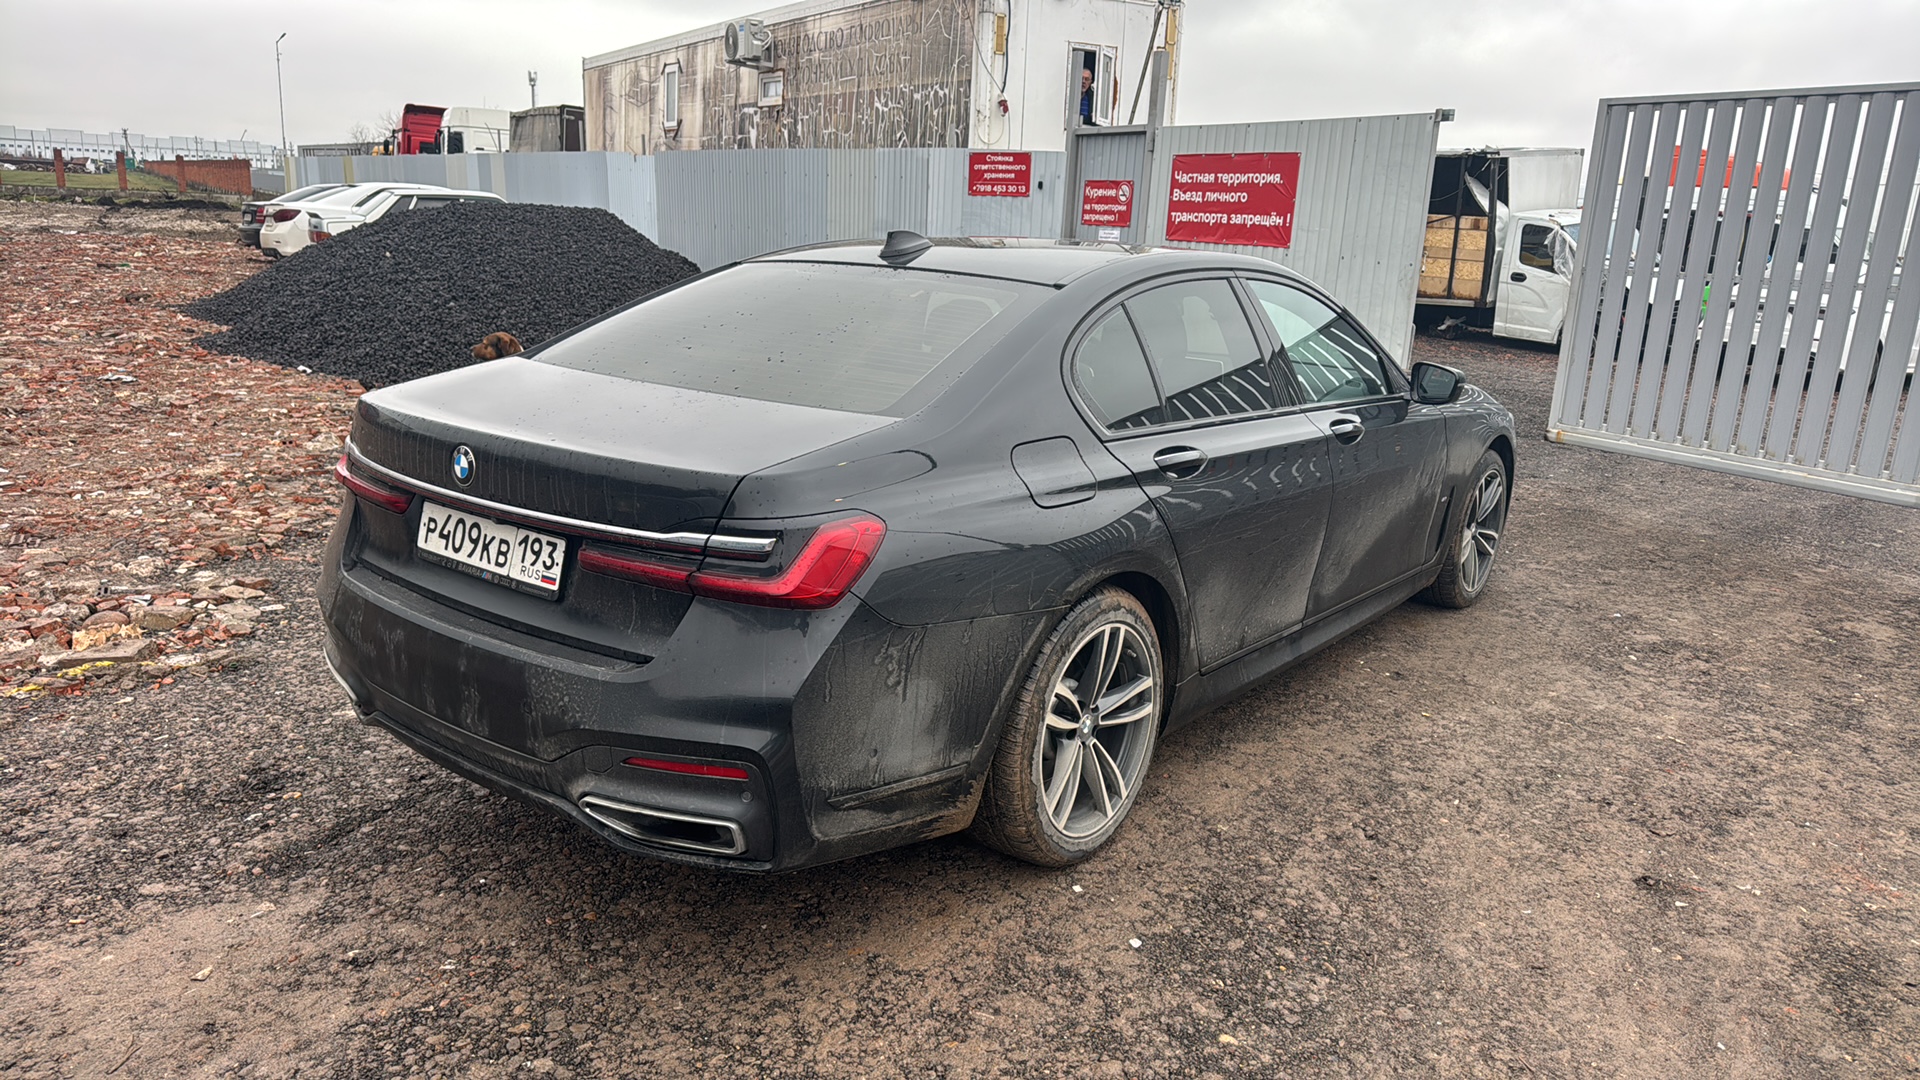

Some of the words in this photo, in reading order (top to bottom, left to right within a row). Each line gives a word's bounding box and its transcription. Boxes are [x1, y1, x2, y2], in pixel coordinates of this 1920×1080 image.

[986, 154, 1014, 162] Стоянка
[983, 172, 1015, 180] хранения
[1174, 170, 1215, 184] Частная
[1217, 172, 1284, 187] территория.
[972, 184, 992, 192] +7918
[993, 184, 1006, 192] 453
[1007, 185, 1017, 193] 30
[1018, 185, 1026, 193] 13
[1085, 186, 1117, 199] Курение
[1172, 188, 1203, 203] Въезд
[1203, 191, 1248, 203] личного
[1091, 204, 1127, 213] территории
[1083, 213, 1115, 222] запрещено
[1170, 211, 1228, 226] транспорта
[1229, 211, 1284, 228] запрещён
[424, 514, 511, 569] Р409КВ
[518, 534, 558, 571] 193
[520, 565, 541, 580] RUS
